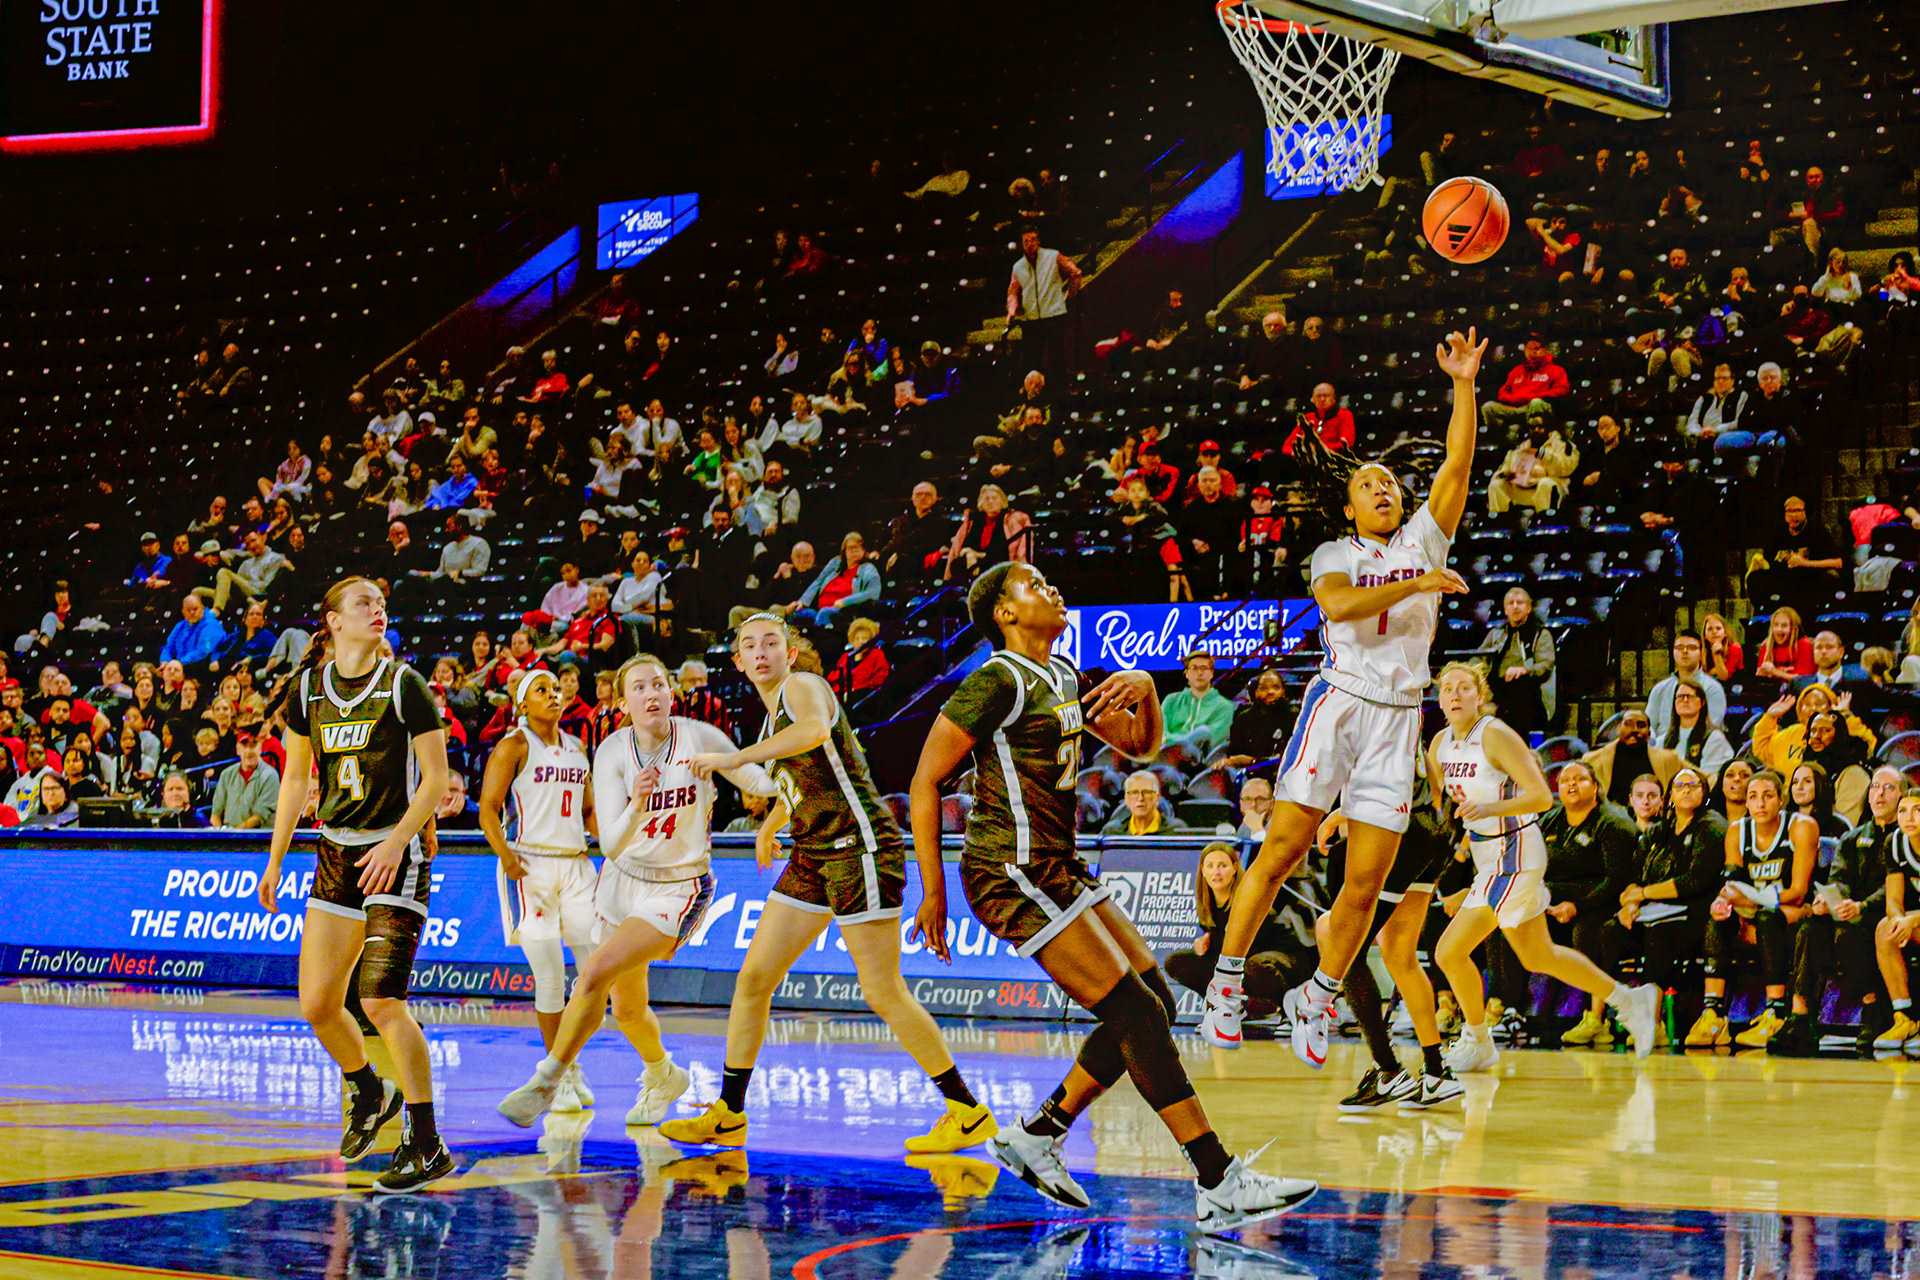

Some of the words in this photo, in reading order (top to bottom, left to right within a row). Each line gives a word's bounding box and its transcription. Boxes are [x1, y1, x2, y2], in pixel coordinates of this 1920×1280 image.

[45, 22, 152, 66] STATE
[67, 60, 130, 81] BANK
[643, 210, 663, 222] Bon
[1096, 608, 1180, 670] Real
[1058, 703, 1082, 732] VCU
[322, 723, 371, 750] VCU
[338, 755, 365, 801] 4
[561, 790, 573, 818] 0
[645, 785, 697, 812] IDERS
[642, 813, 677, 839] 44
[163, 869, 258, 898] PROUD
[1144, 871, 1195, 895] REAL
[1750, 861, 1781, 879] VCU
[130, 909, 178, 937] THE
[183, 911, 304, 942] RICHMON
[1162, 925, 1197, 938] METRO
[18, 948, 205, 978] FindYourNest.com
